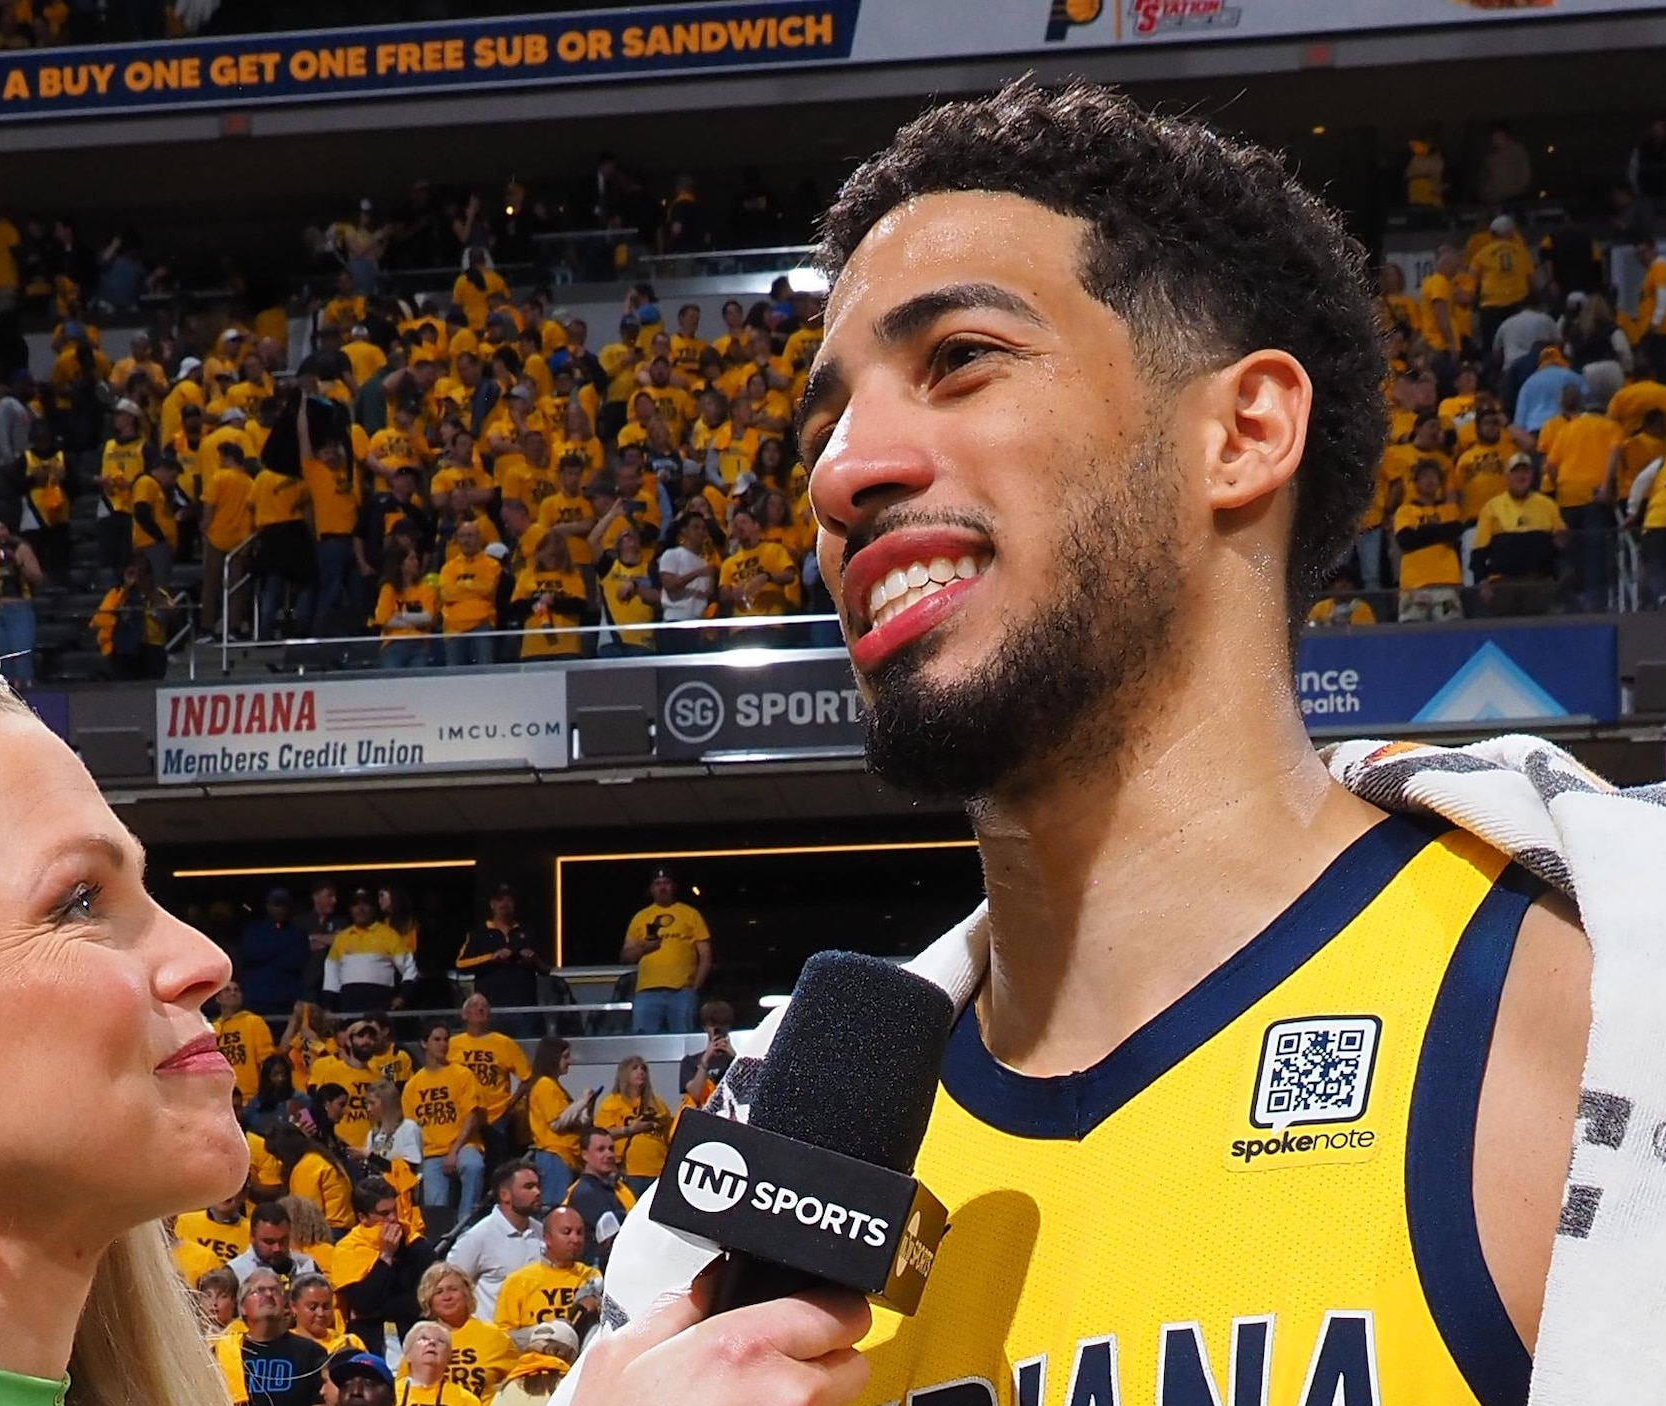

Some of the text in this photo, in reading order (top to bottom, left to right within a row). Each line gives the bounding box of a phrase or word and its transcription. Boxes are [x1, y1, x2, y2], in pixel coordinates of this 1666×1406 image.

[2, 70, 31, 100] A
[38, 63, 116, 98] BUY
[123, 58, 202, 92] ONE
[209, 51, 280, 87] GET
[289, 46, 368, 80] ONE
[375, 39, 465, 75] FREE
[473, 34, 549, 68] SUB
[557, 27, 613, 62] OR
[621, 13, 834, 59] SANDWICH
[167, 690, 562, 741] INDIANA IMCU.COM
[674, 697, 714, 728] SG
[1300, 693, 1361, 715] ealth
[162, 738, 426, 776] Members Credit Union
[463, 1050, 494, 1062] YES
[352, 1082, 371, 1095] YE
[419, 1086, 449, 1101] YES
[1230, 1126, 1376, 1162] spokenote
[681, 1157, 890, 1248] TNT SPORTS
[197, 1237, 239, 1260] YES
